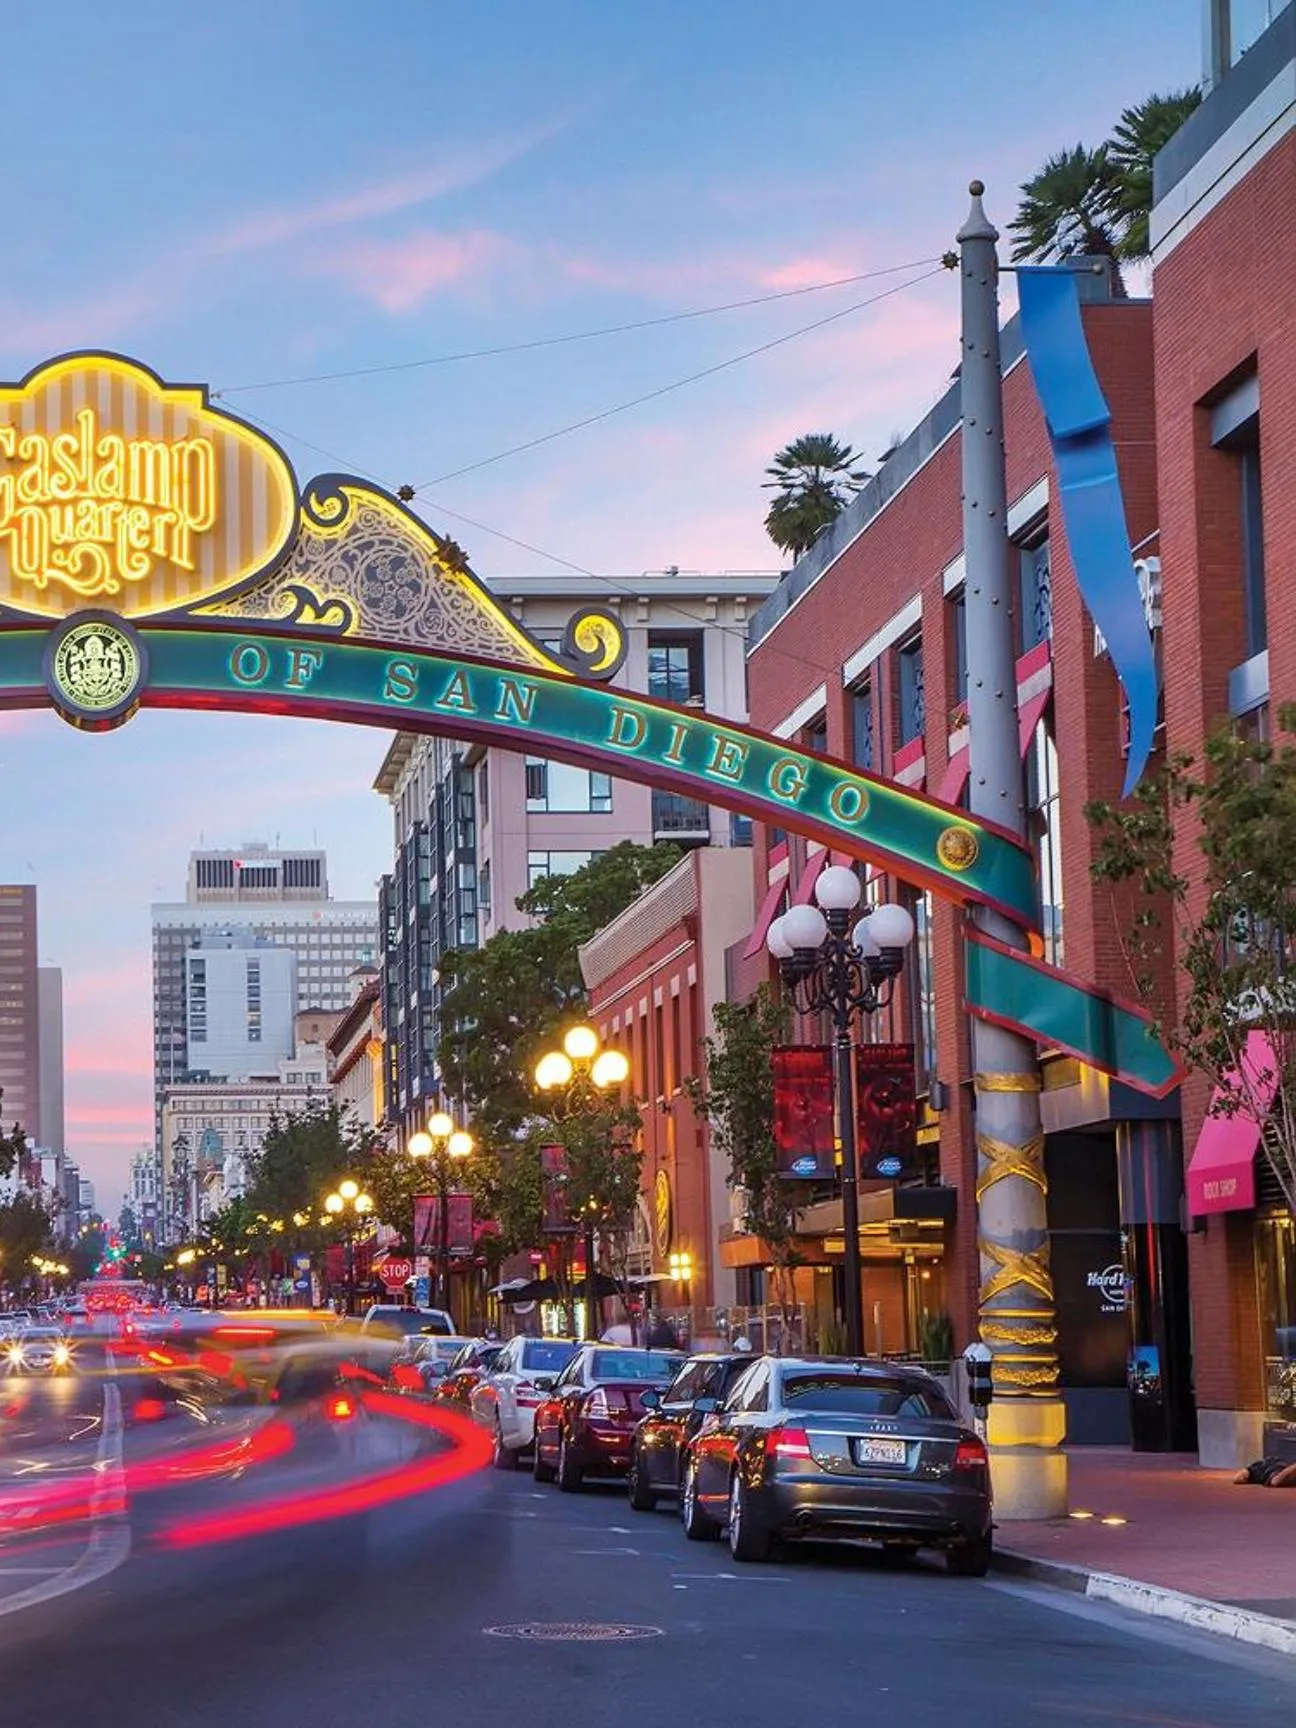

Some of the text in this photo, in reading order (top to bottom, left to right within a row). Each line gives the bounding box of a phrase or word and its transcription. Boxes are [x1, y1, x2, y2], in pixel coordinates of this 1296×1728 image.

[230, 640, 324, 690] OF
[382, 659, 540, 724] SAN
[606, 704, 871, 825] DIEGO
[383, 1263, 409, 1278] STOP
[1087, 1271, 1118, 1287] Hard
